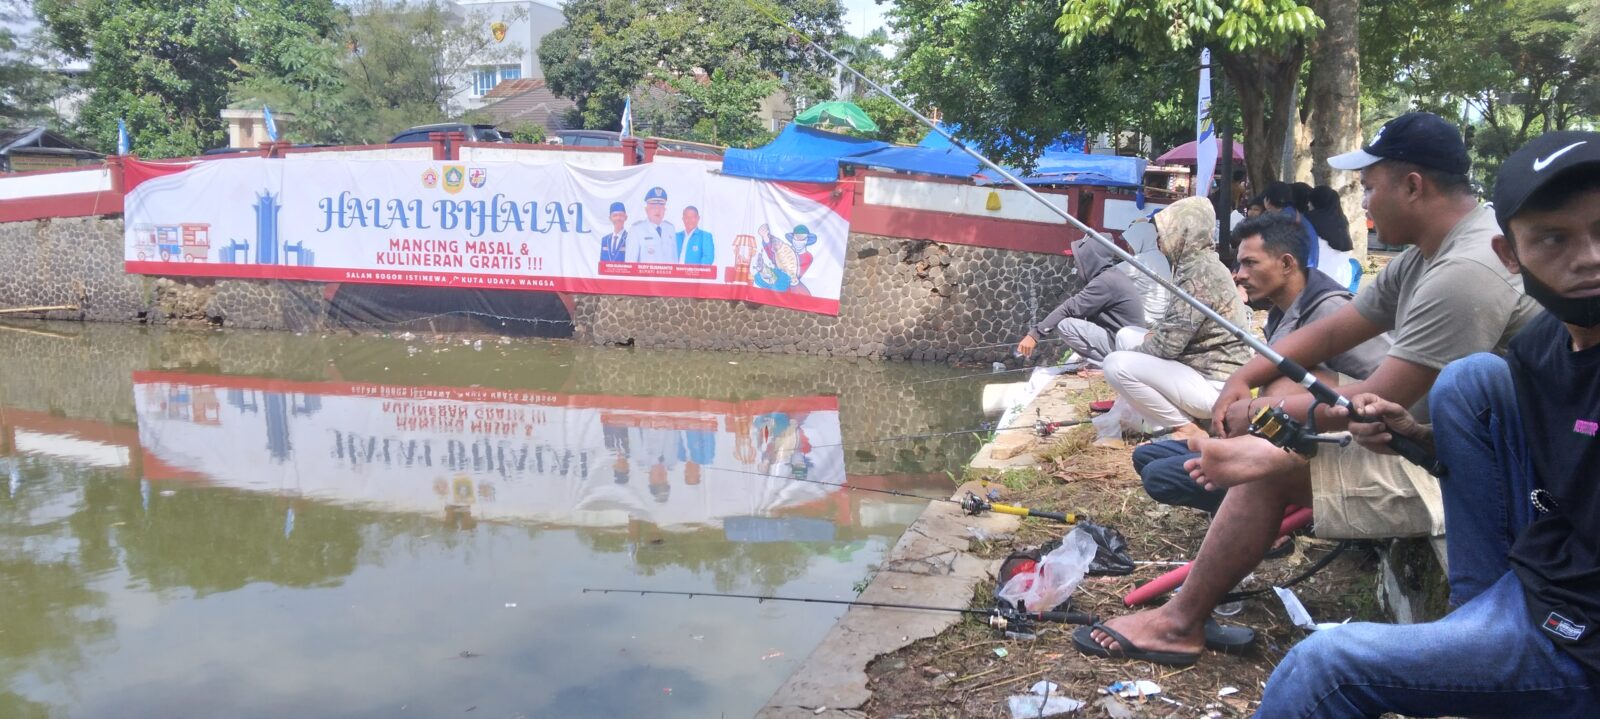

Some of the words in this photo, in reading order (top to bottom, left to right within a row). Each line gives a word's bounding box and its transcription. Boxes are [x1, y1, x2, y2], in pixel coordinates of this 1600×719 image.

[317, 191, 431, 233] HALAL
[432, 193, 592, 237] BIHALAL
[389, 238, 458, 254] MANCING
[465, 241, 513, 255] MASAL
[520, 242, 529, 256] &
[376, 251, 463, 268] KULINERAN
[469, 255, 521, 270] GRATIS
[527, 257, 542, 270] !!!
[345, 271, 372, 279] SALAM
[375, 273, 402, 281] BOGOR
[405, 274, 447, 283] ISTIMEWA
[461, 276, 484, 284] KUTA
[519, 279, 555, 287] WANGSA
